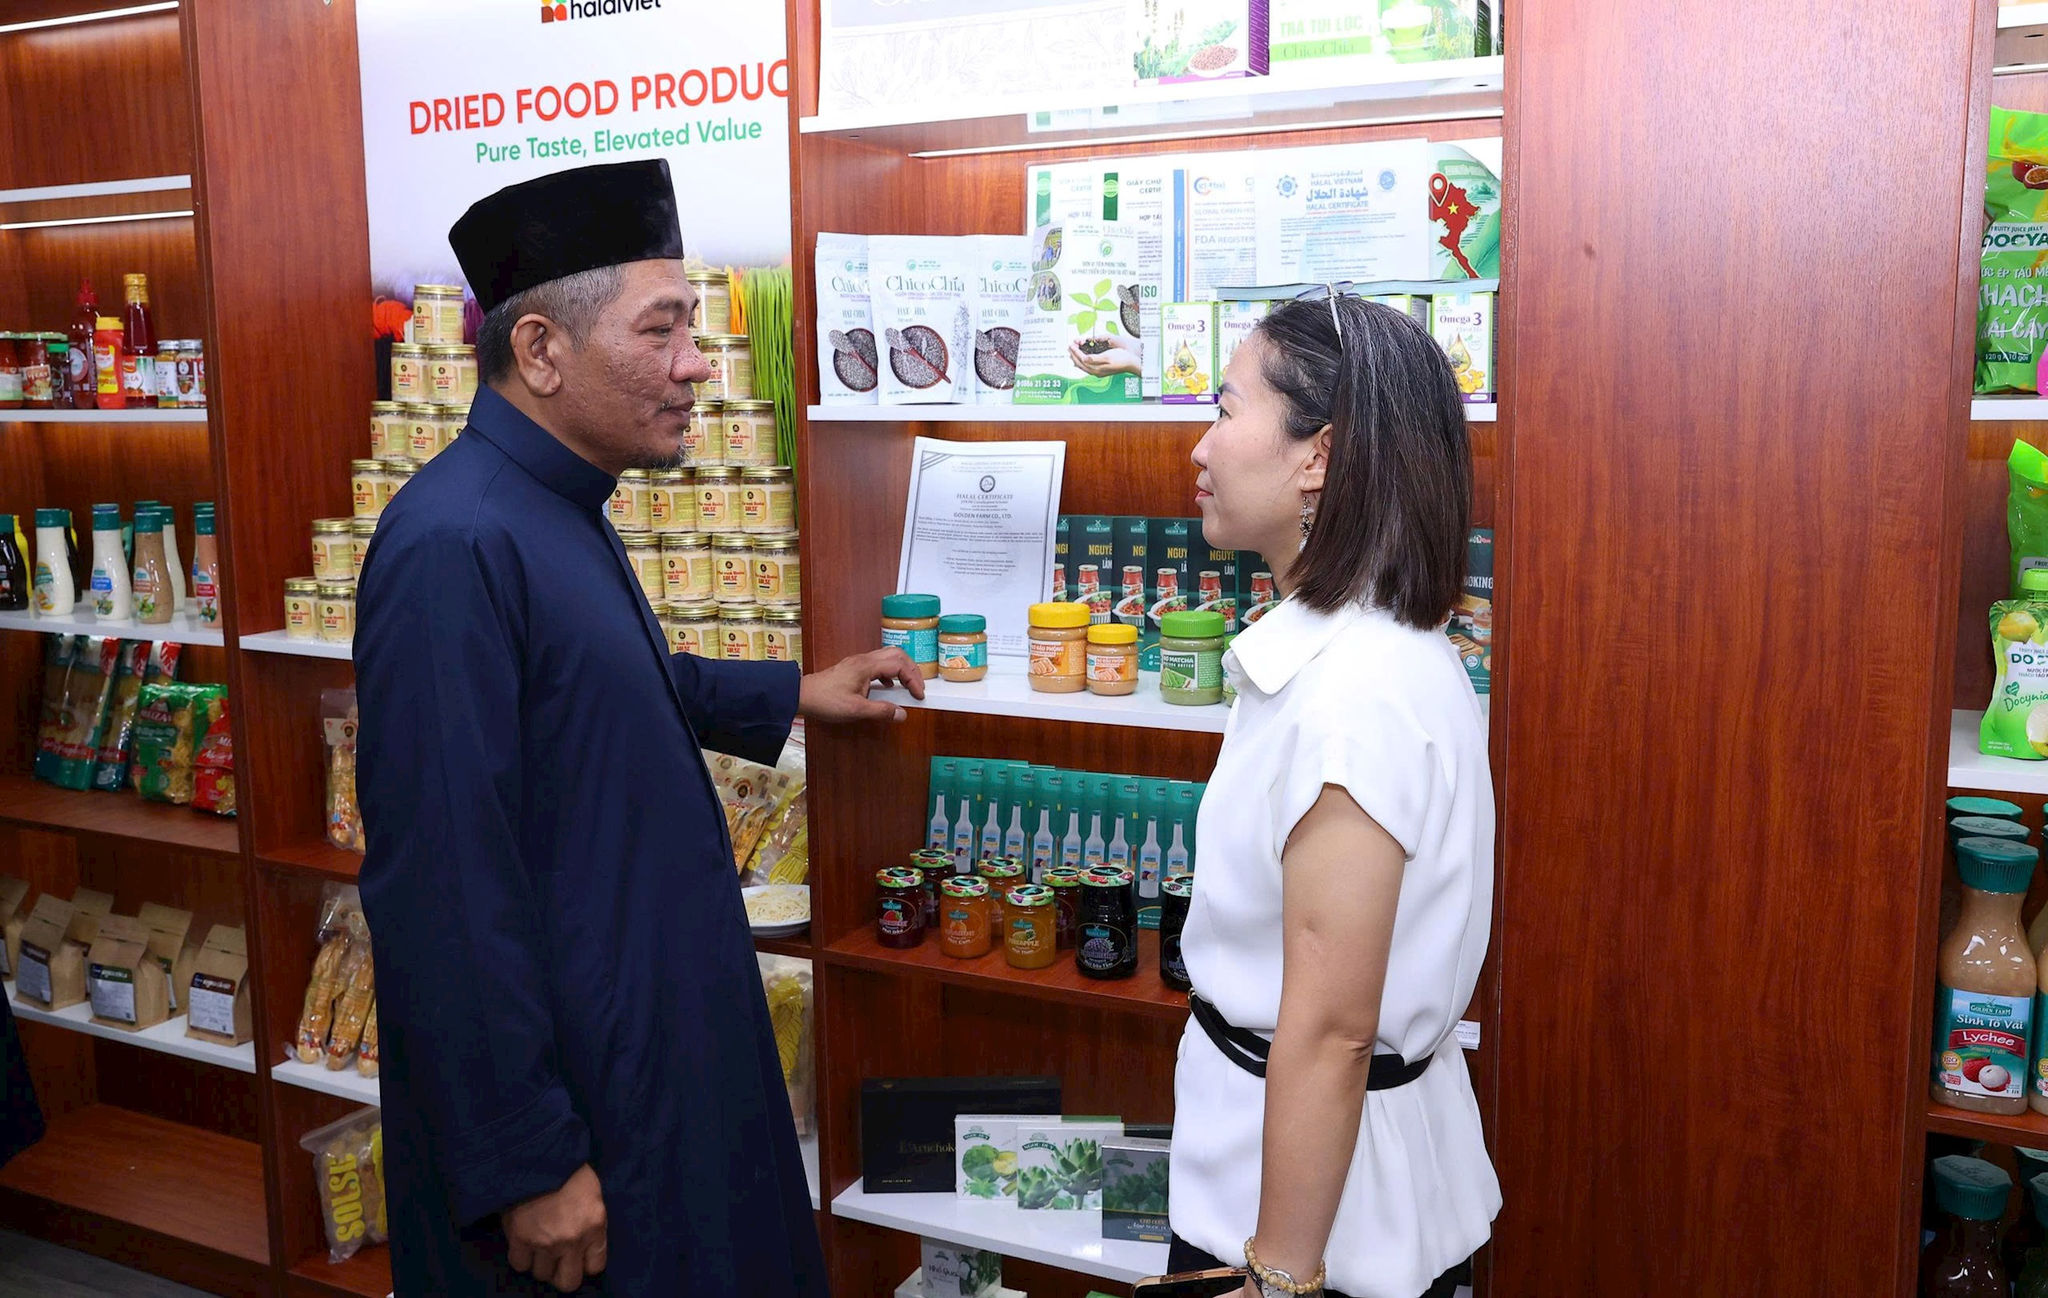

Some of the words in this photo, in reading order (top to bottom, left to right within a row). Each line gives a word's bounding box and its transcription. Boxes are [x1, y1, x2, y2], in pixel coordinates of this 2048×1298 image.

[409, 92, 505, 135] DRIED
[516, 80, 619, 124] FOOD
[476, 142, 521, 164] Pure
[526, 134, 588, 158] Taste,
[594, 122, 690, 153] Elevated
[697, 118, 763, 144] Value
[1140, 285, 1158, 298] ISO
[1197, 319, 1206, 332] 3
[1473, 312, 1482, 326] 3
[1957, 1014, 1985, 1026] Sinh
[1962, 1031, 2016, 1047] Lychee
